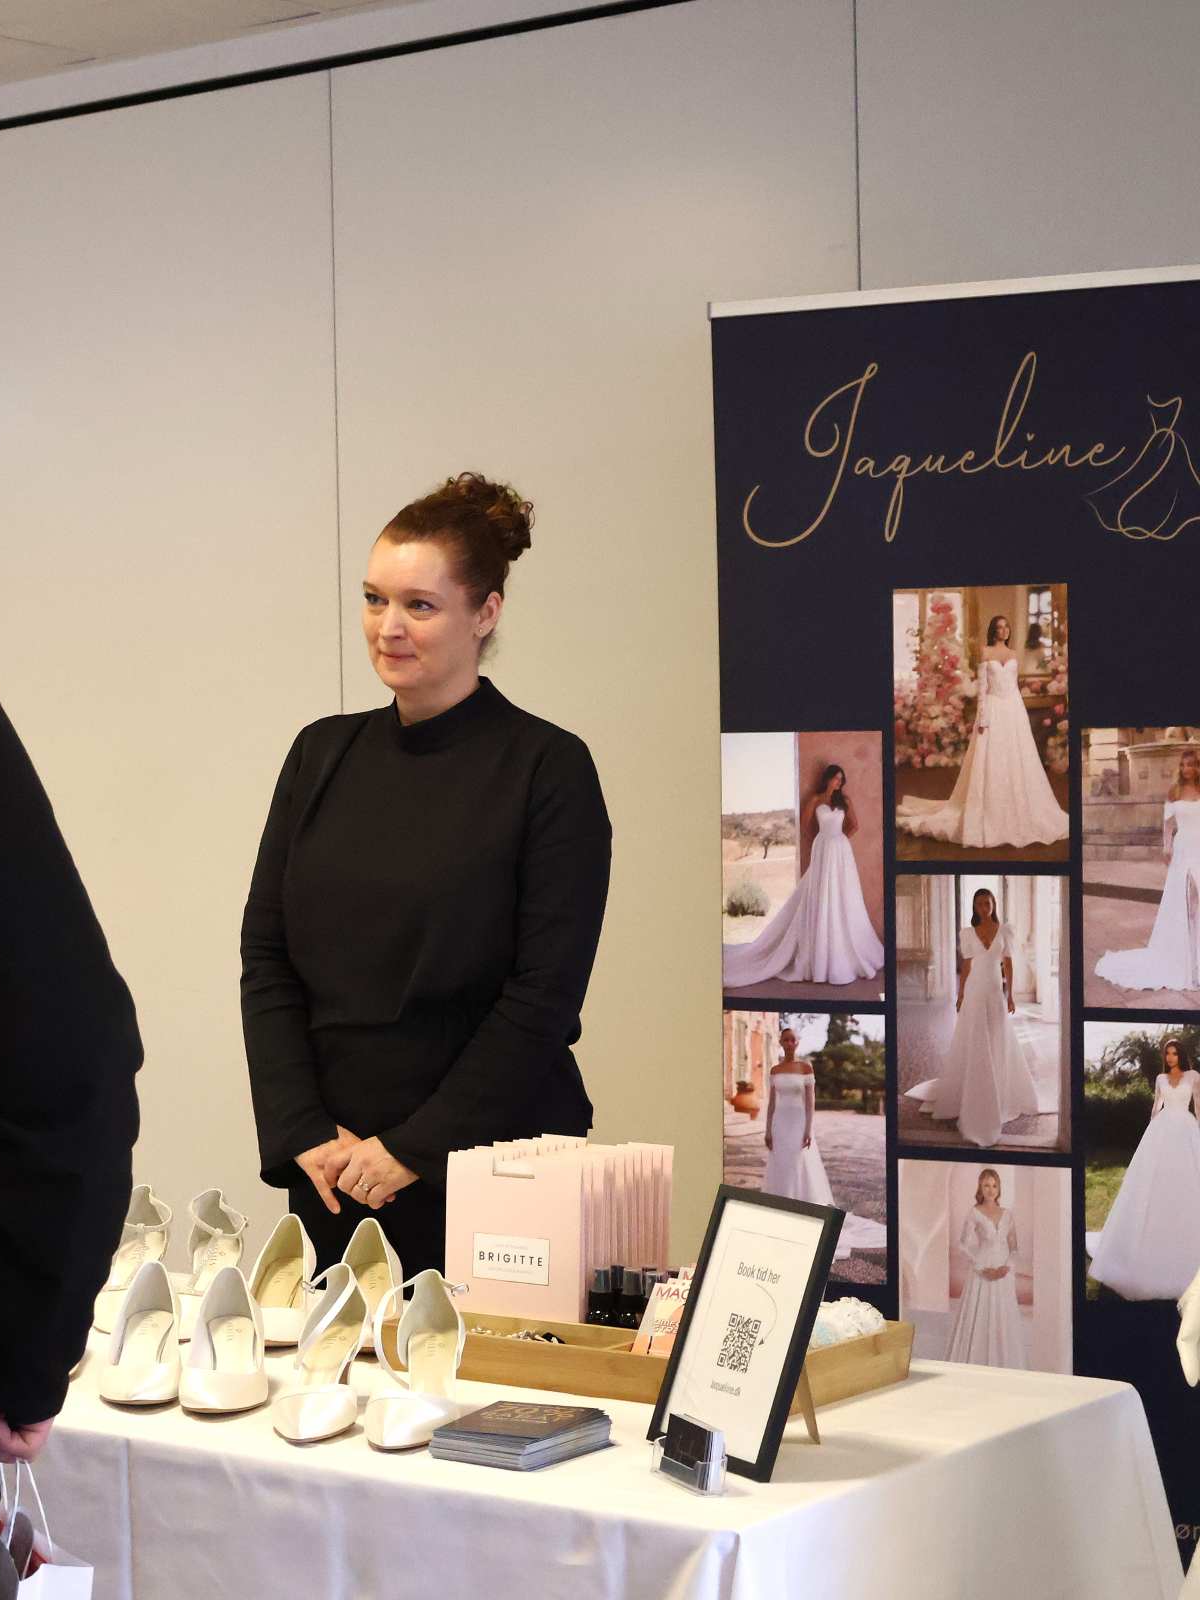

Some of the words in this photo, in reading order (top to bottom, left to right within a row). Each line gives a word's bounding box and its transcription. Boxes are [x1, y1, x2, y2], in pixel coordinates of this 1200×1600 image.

[742, 351, 1126, 548] Jaqueline
[479, 1250, 543, 1267] BRIGITTE
[737, 1260, 756, 1279] Book
[756, 1267, 769, 1281] tid
